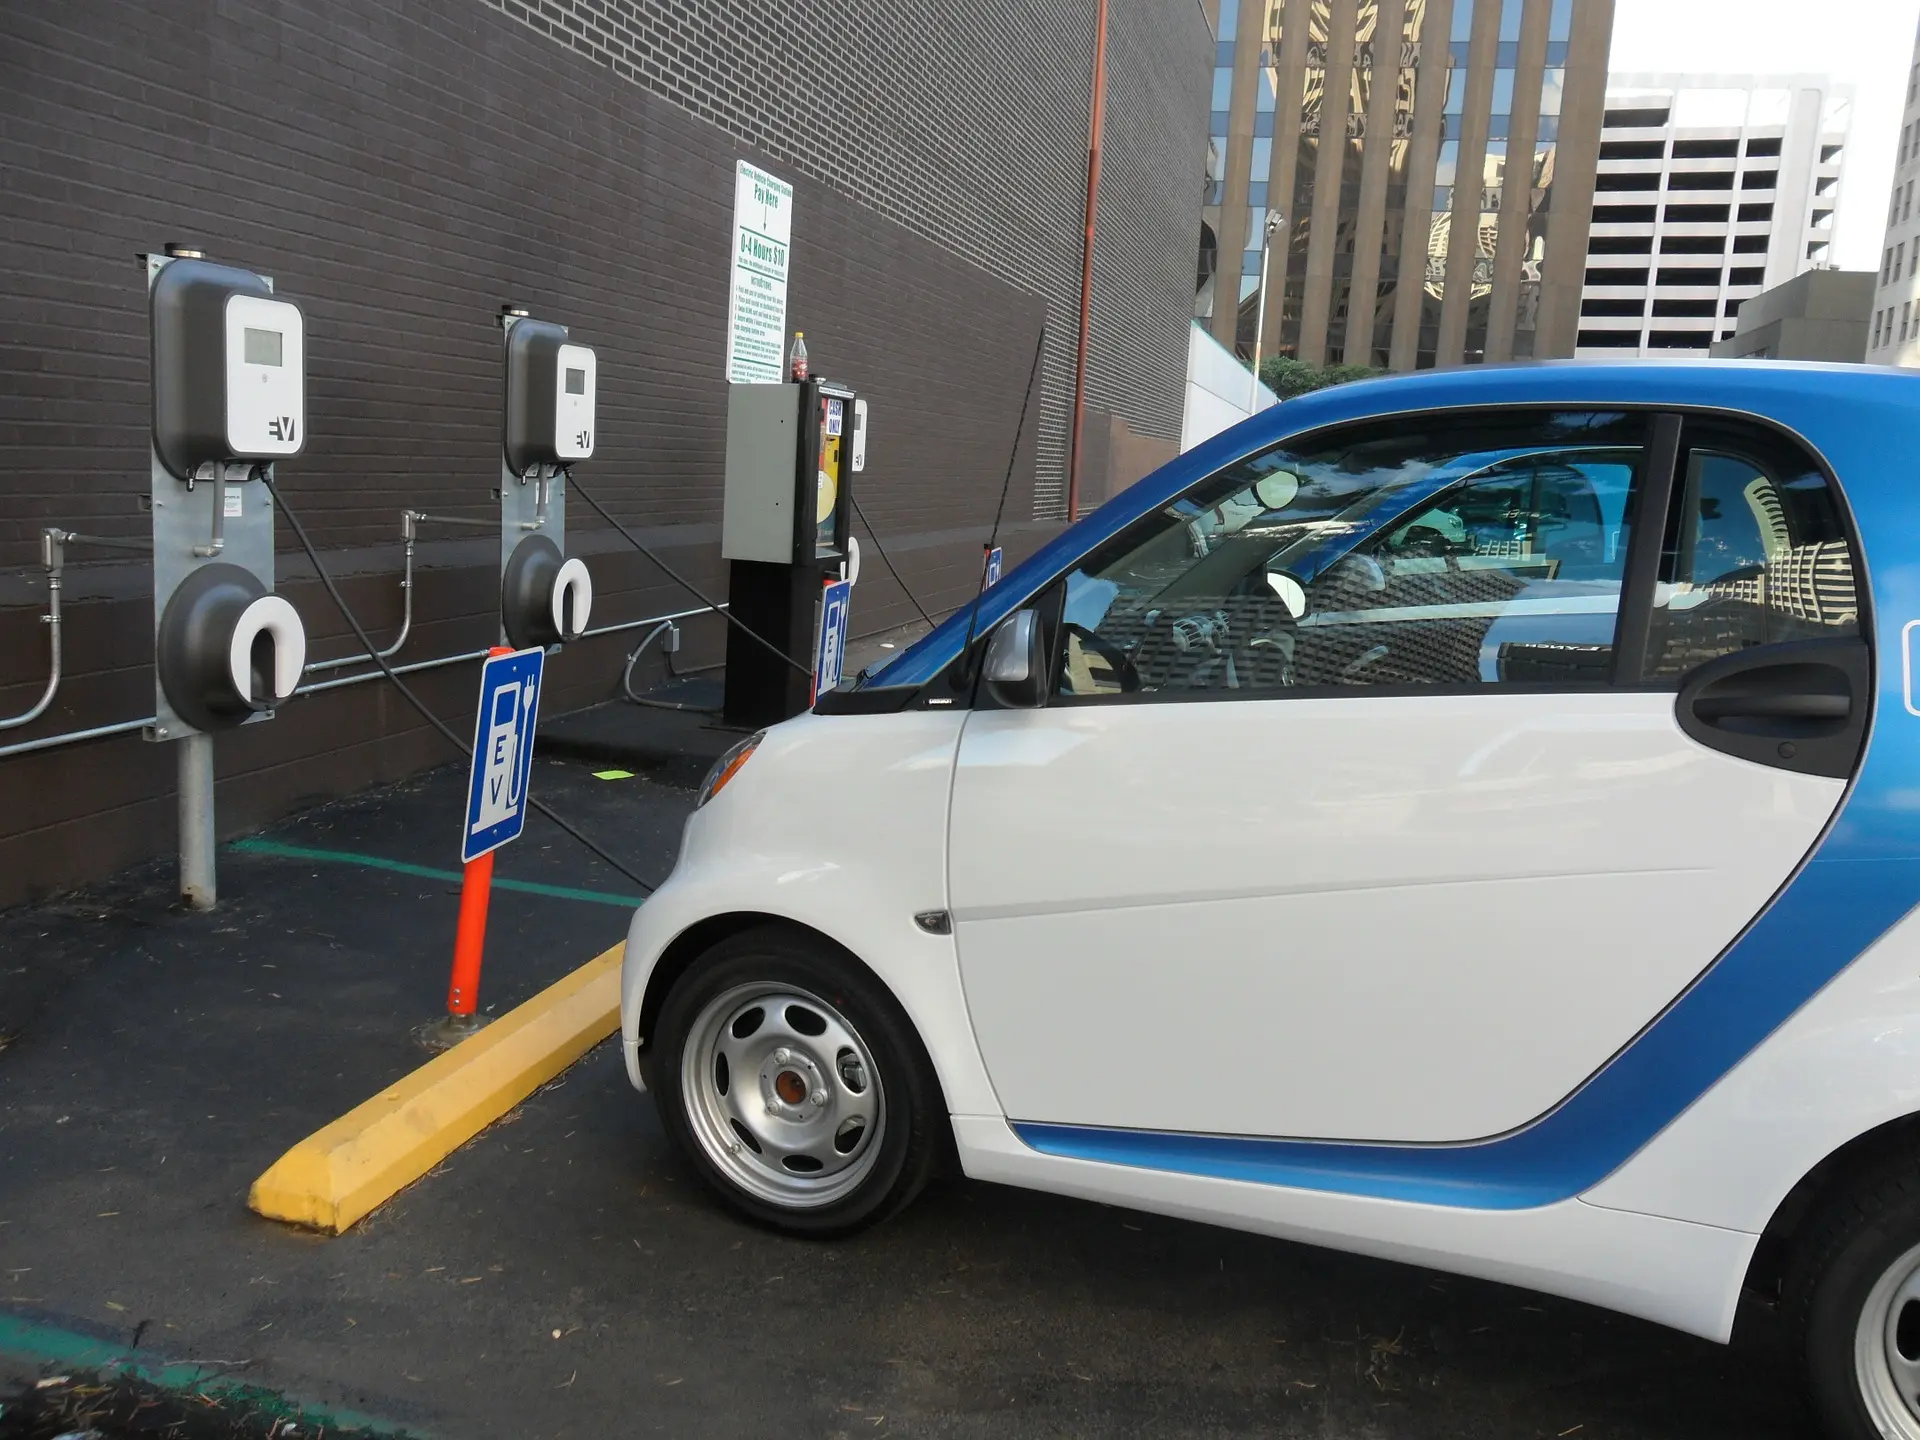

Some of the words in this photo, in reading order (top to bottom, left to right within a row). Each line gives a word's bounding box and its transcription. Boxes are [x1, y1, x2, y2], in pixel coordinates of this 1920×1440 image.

[754, 183, 764, 204] Pay
[765, 188, 778, 208] Here
[741, 233, 752, 255] 0-4
[753, 238, 772, 262] Hours
[773, 246, 785, 267] $10
[829, 400, 842, 416] CASH
[268, 416, 295, 441] EV
[829, 418, 841, 433] ONLY
[577, 430, 590, 448] EV
